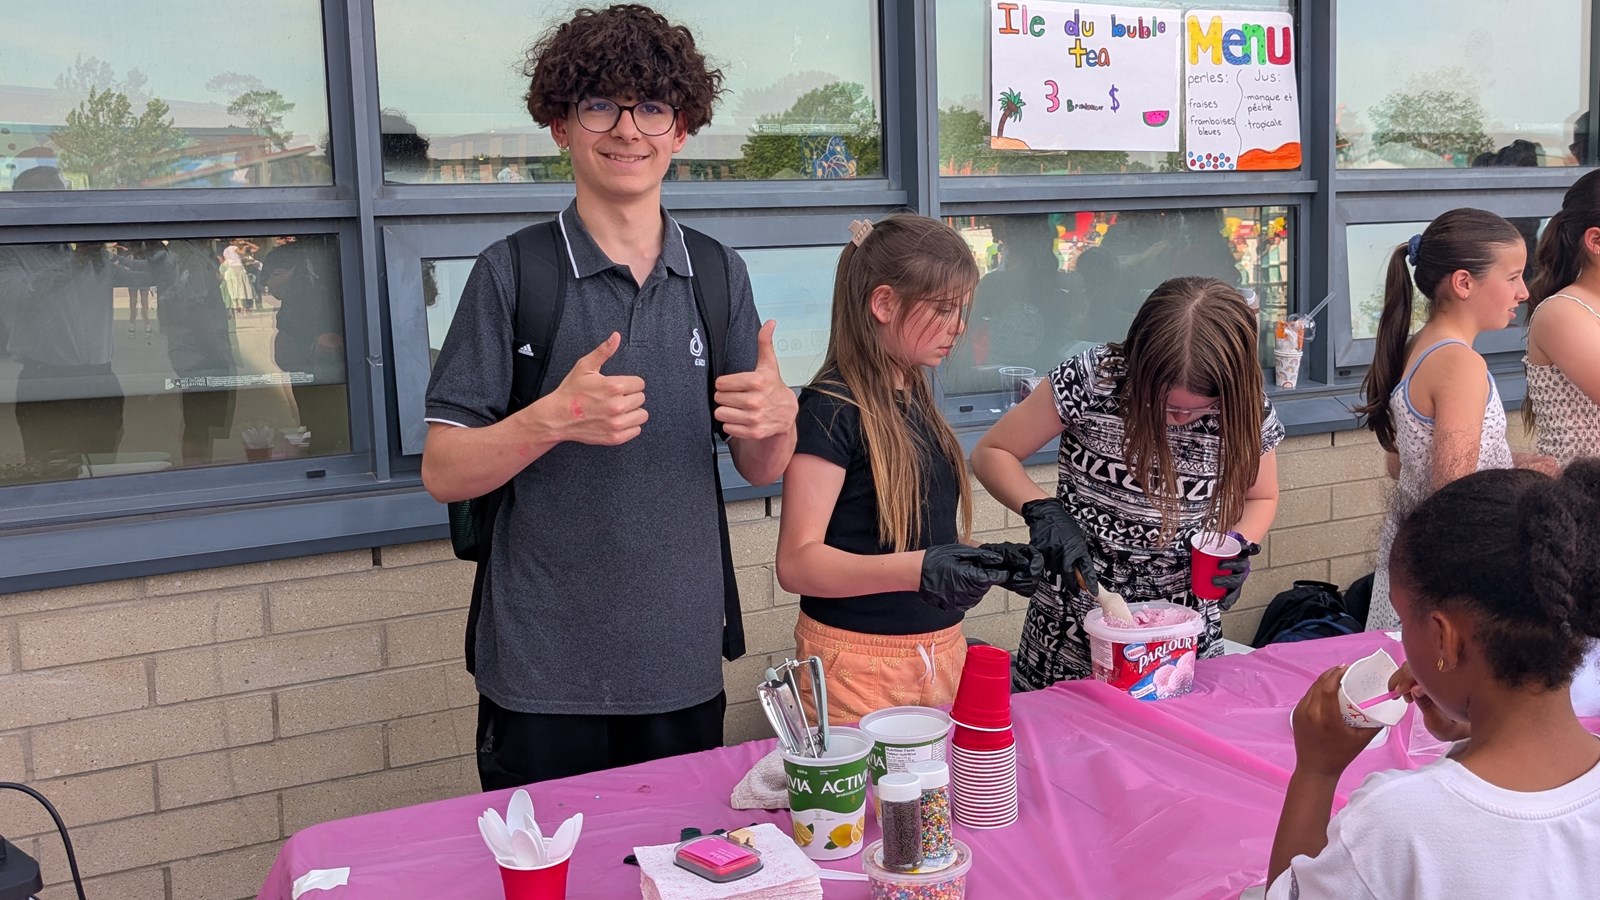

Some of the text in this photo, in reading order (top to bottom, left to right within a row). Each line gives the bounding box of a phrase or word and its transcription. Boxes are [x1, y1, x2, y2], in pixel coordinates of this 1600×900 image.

[997, 3, 1167, 39] Ile du buble
[1187, 15, 1292, 66] Menu
[1068, 38, 1111, 68] tea
[1044, 80, 1060, 113] 3
[1108, 84, 1121, 114] $
[1189, 98, 1219, 109] fraises
[1284, 92, 1293, 102] et
[1190, 115, 1236, 126] framboises
[1247, 118, 1283, 131] tropicale
[1198, 127, 1222, 136] bleues
[1138, 637, 1193, 674] PARLOUR
